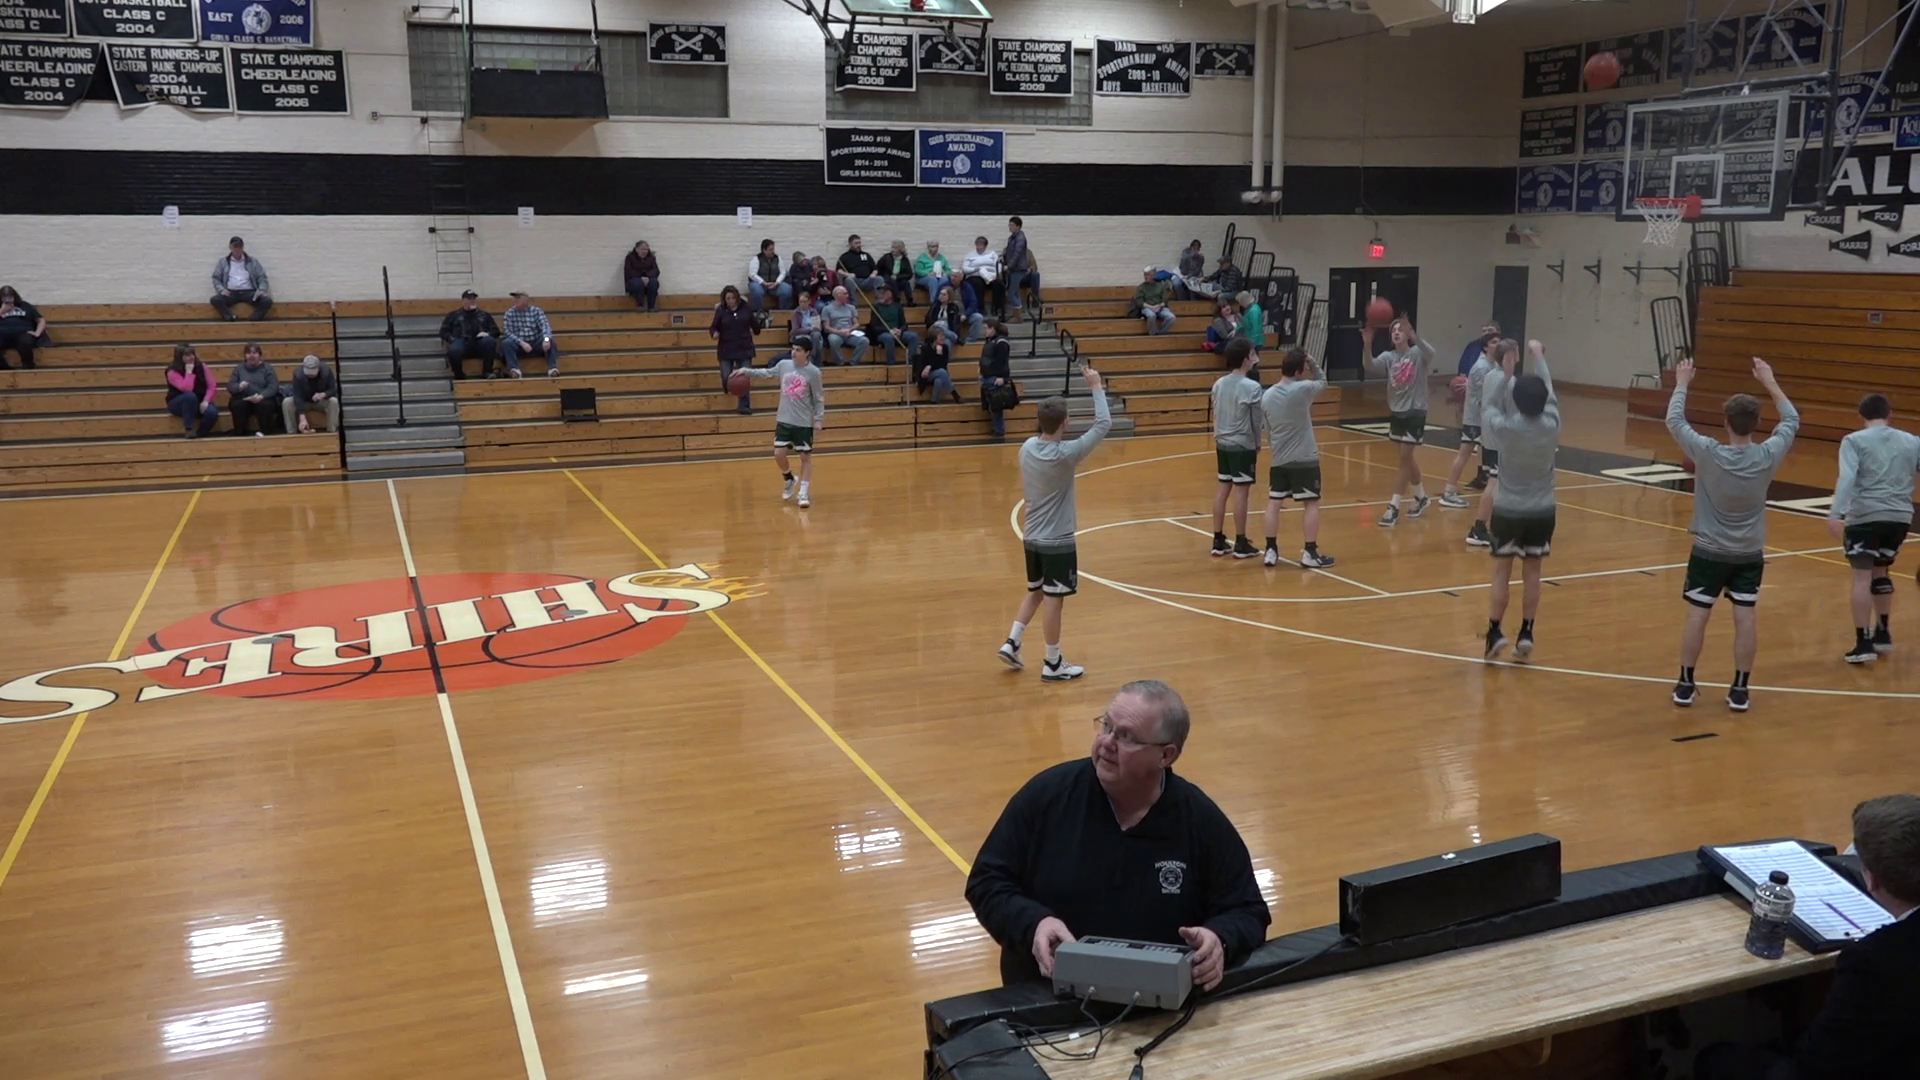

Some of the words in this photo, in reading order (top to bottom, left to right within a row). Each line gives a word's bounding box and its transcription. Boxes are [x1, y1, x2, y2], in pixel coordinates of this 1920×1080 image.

[103, 8, 151, 20] CLASS
[156, 11, 166, 20] C
[207, 11, 234, 22] EAST
[29, 20, 40, 30] C
[115, 23, 155, 34] 2004
[862, 34, 908, 46] CHAMPIONS
[27, 45, 93, 59] CHAMPIONS
[857, 45, 902, 56] CHAMPIONS
[998, 41, 1021, 51] STATE
[1024, 42, 1066, 53] CHAMPIONS
[111, 47, 146, 59] STATE
[150, 49, 220, 61] RUNNERS-UP
[240, 53, 276, 65] STATE
[279, 54, 334, 66] CHAMPIONS
[1003, 52, 1018, 61] PVC
[1021, 53, 1061, 63] CHAMPIONS
[113, 60, 148, 72] EASTERN
[151, 61, 177, 73] MAINE
[180, 63, 223, 74] CHAMPIONS
[877, 57, 908, 67] CHAMPIONS
[1097, 53, 1157, 79] SPORTSMANSHIP
[1165, 58, 1190, 80] AWARD
[870, 67, 877, 76] C
[879, 68, 901, 76] GOLF
[1037, 63, 1067, 73] CHAMPIONS
[149, 74, 188, 84] 2004
[241, 68, 337, 81] CHEERLEADING
[1005, 73, 1030, 81] CLASS
[1040, 74, 1059, 82] GOLF
[10, 76, 60, 87] CLASS
[65, 78, 76, 88] C
[1102, 81, 1121, 92] BOYS
[1141, 82, 1184, 93] BASKETBALL
[261, 84, 305, 94] CLASS
[309, 85, 319, 94] C
[24, 90, 65, 101] 2004
[191, 96, 202, 105] C
[830, 146, 886, 157] SPORTSMANSHIP
[886, 148, 911, 158] AWARD
[947, 143, 976, 152] AWARD
[921, 160, 943, 168] EAST
[945, 160, 952, 168] D
[981, 160, 1001, 168] 2014
[860, 170, 903, 178] BASKETBALL
[1809, 214, 1841, 224] CROUSE
[1874, 211, 1899, 221] FORD
[1839, 241, 1868, 250] HARRIS
[0, 563, 730, 724] SHIRES
[1154, 861, 1187, 869] HOULTON
